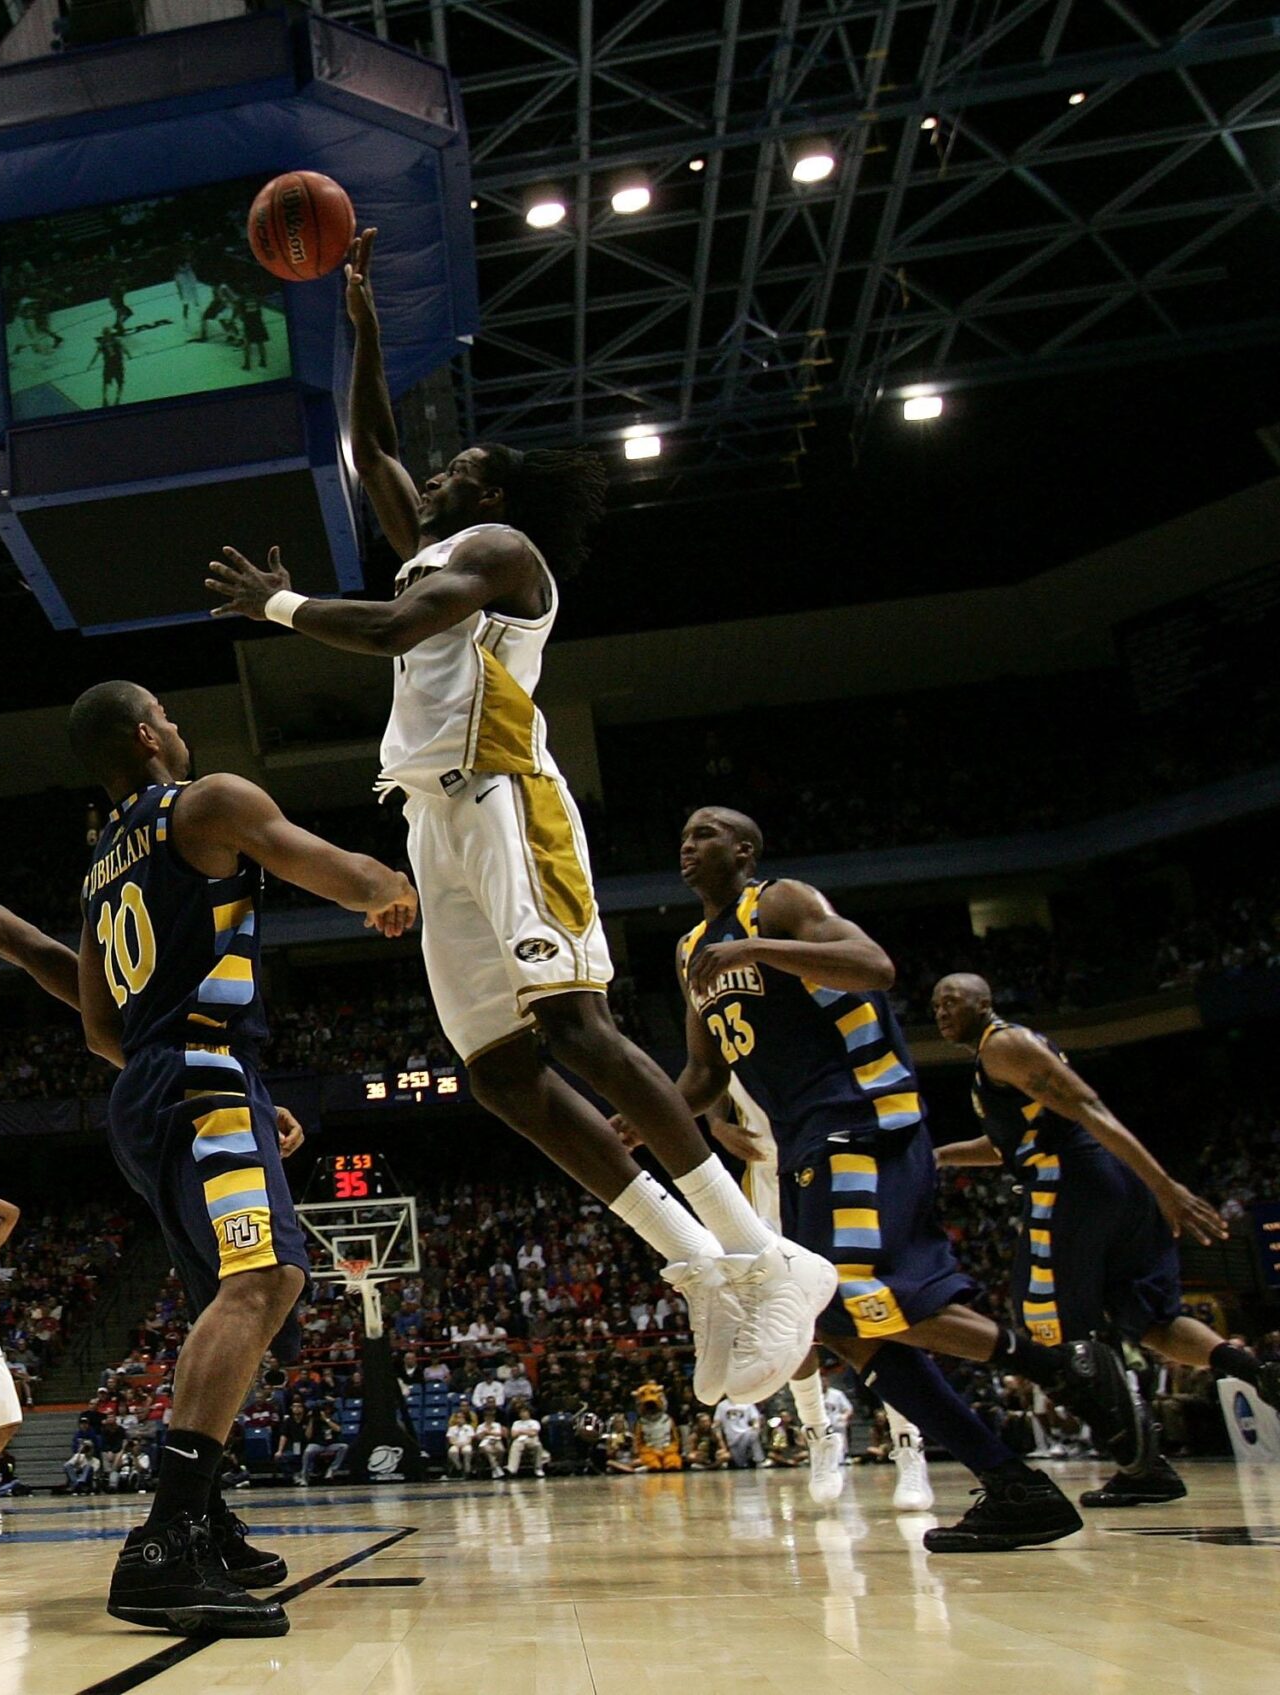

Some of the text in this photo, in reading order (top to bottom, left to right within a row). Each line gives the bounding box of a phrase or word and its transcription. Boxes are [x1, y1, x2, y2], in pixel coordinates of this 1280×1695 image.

[97, 881, 156, 1008] 10
[707, 1001, 755, 1064] 23
[334, 1154, 372, 1170] 2:53
[334, 1171, 368, 1198] 35
[225, 1215, 260, 1248] MU
